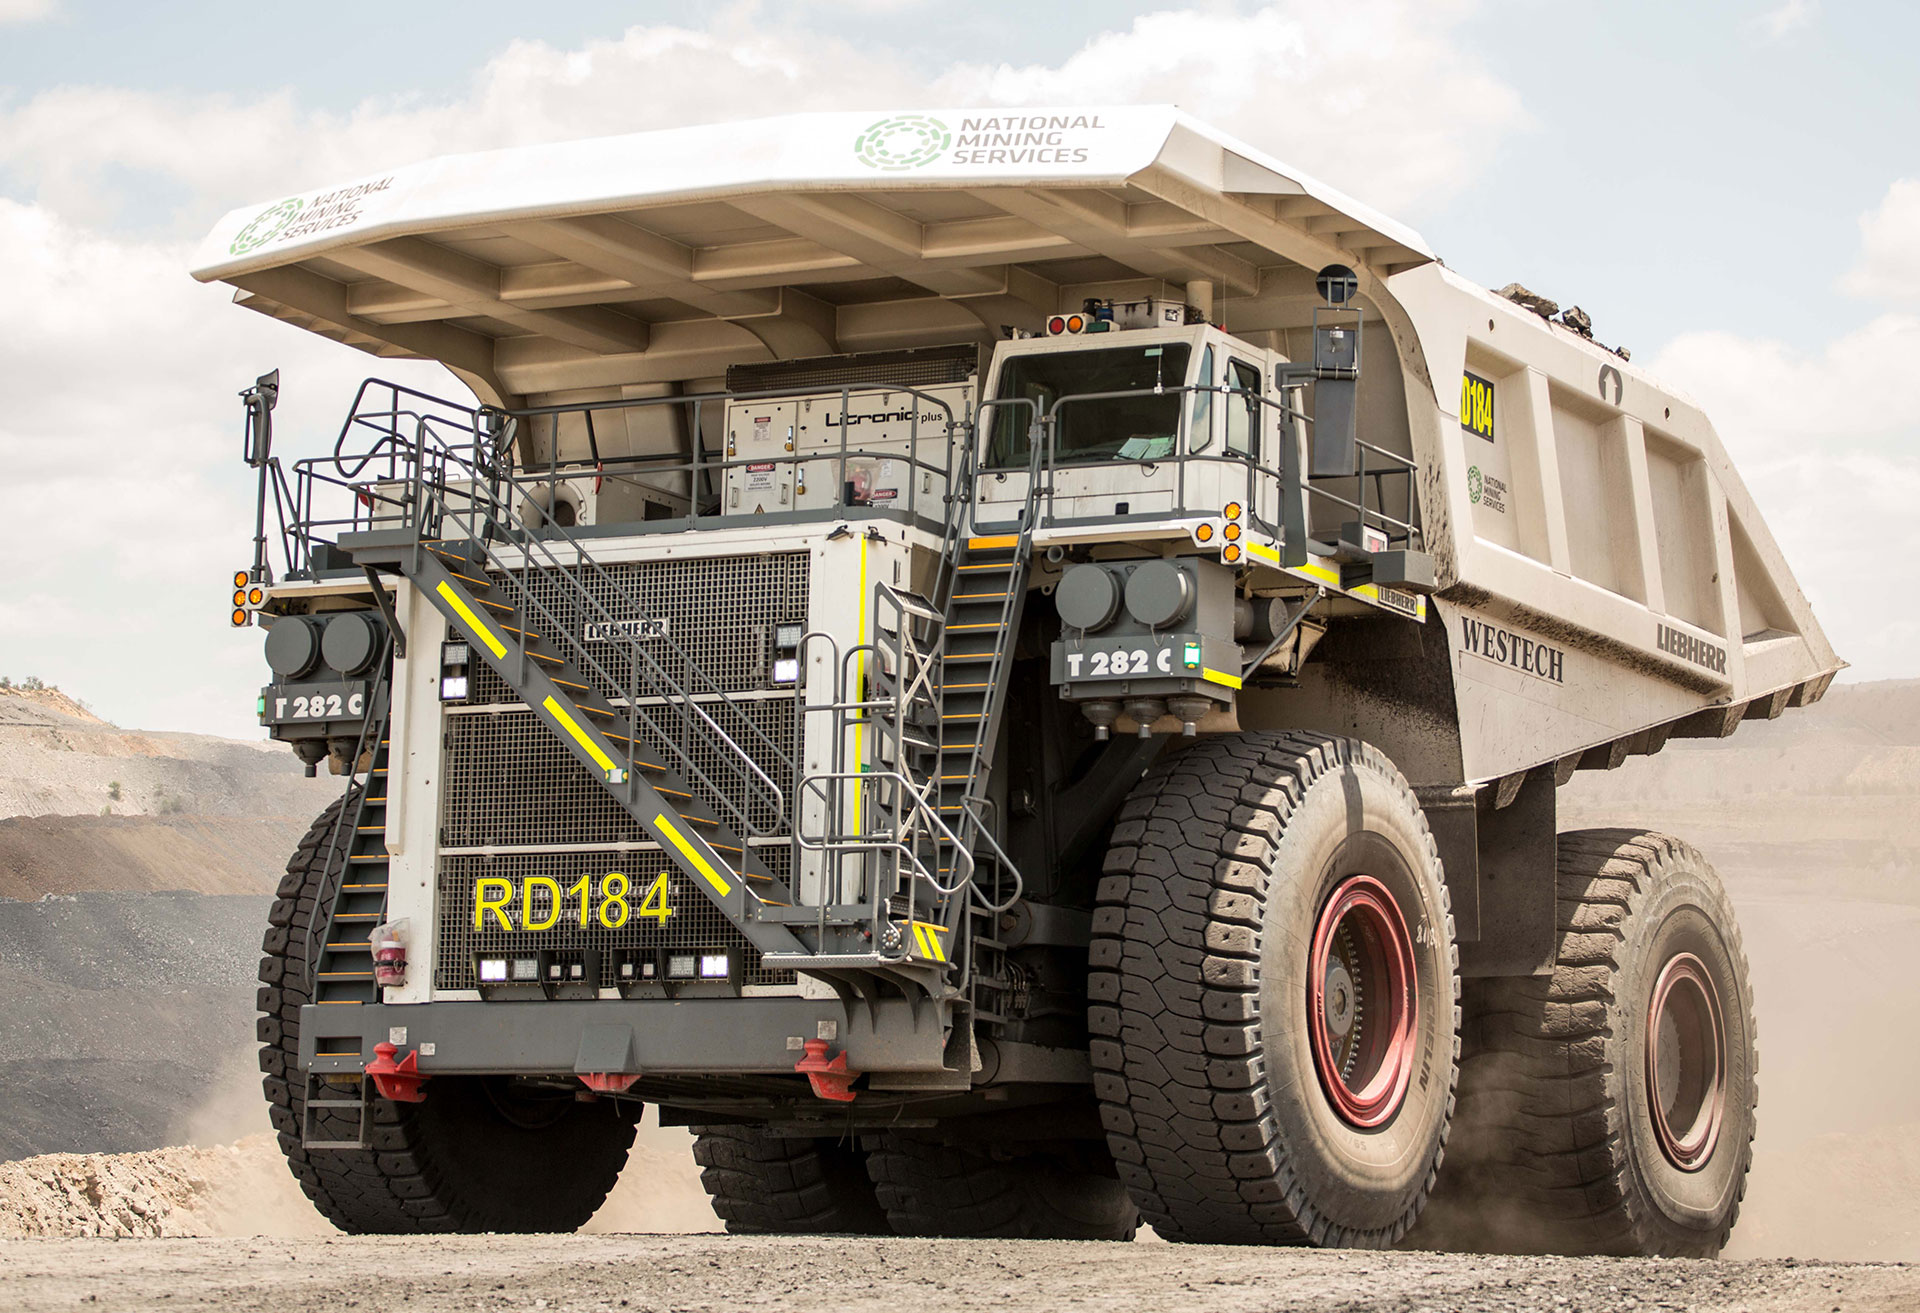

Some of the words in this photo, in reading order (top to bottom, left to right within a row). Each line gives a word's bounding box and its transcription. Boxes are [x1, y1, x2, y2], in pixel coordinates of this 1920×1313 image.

[960, 115, 1105, 131] NATIONAL
[956, 131, 1063, 147] MINING
[952, 148, 1088, 164] SERVICES
[307, 176, 395, 210] NATIONAL
[293, 198, 361, 225] MINING
[278, 210, 363, 241] SERVICES
[825, 406, 919, 427] Litronic
[921, 412, 943, 424] plus
[1484, 474, 1507, 493] NATIONAL
[1484, 485, 1501, 501] MINING
[1483, 496, 1505, 513] SERVICES
[1380, 586, 1415, 612] LIEBHERR
[588, 621, 664, 639] LIEBHERR
[1067, 653, 1083, 676] T
[1089, 649, 1149, 676] 282
[1156, 648, 1171, 672] C
[1461, 616, 1564, 683] WESTECH
[1656, 623, 1727, 675] LIEBHERR
[275, 698, 287, 719] T
[292, 694, 342, 718] 282
[348, 693, 362, 715] C
[474, 871, 674, 932] RD184
[1419, 965, 1436, 1092] MICHELIN
